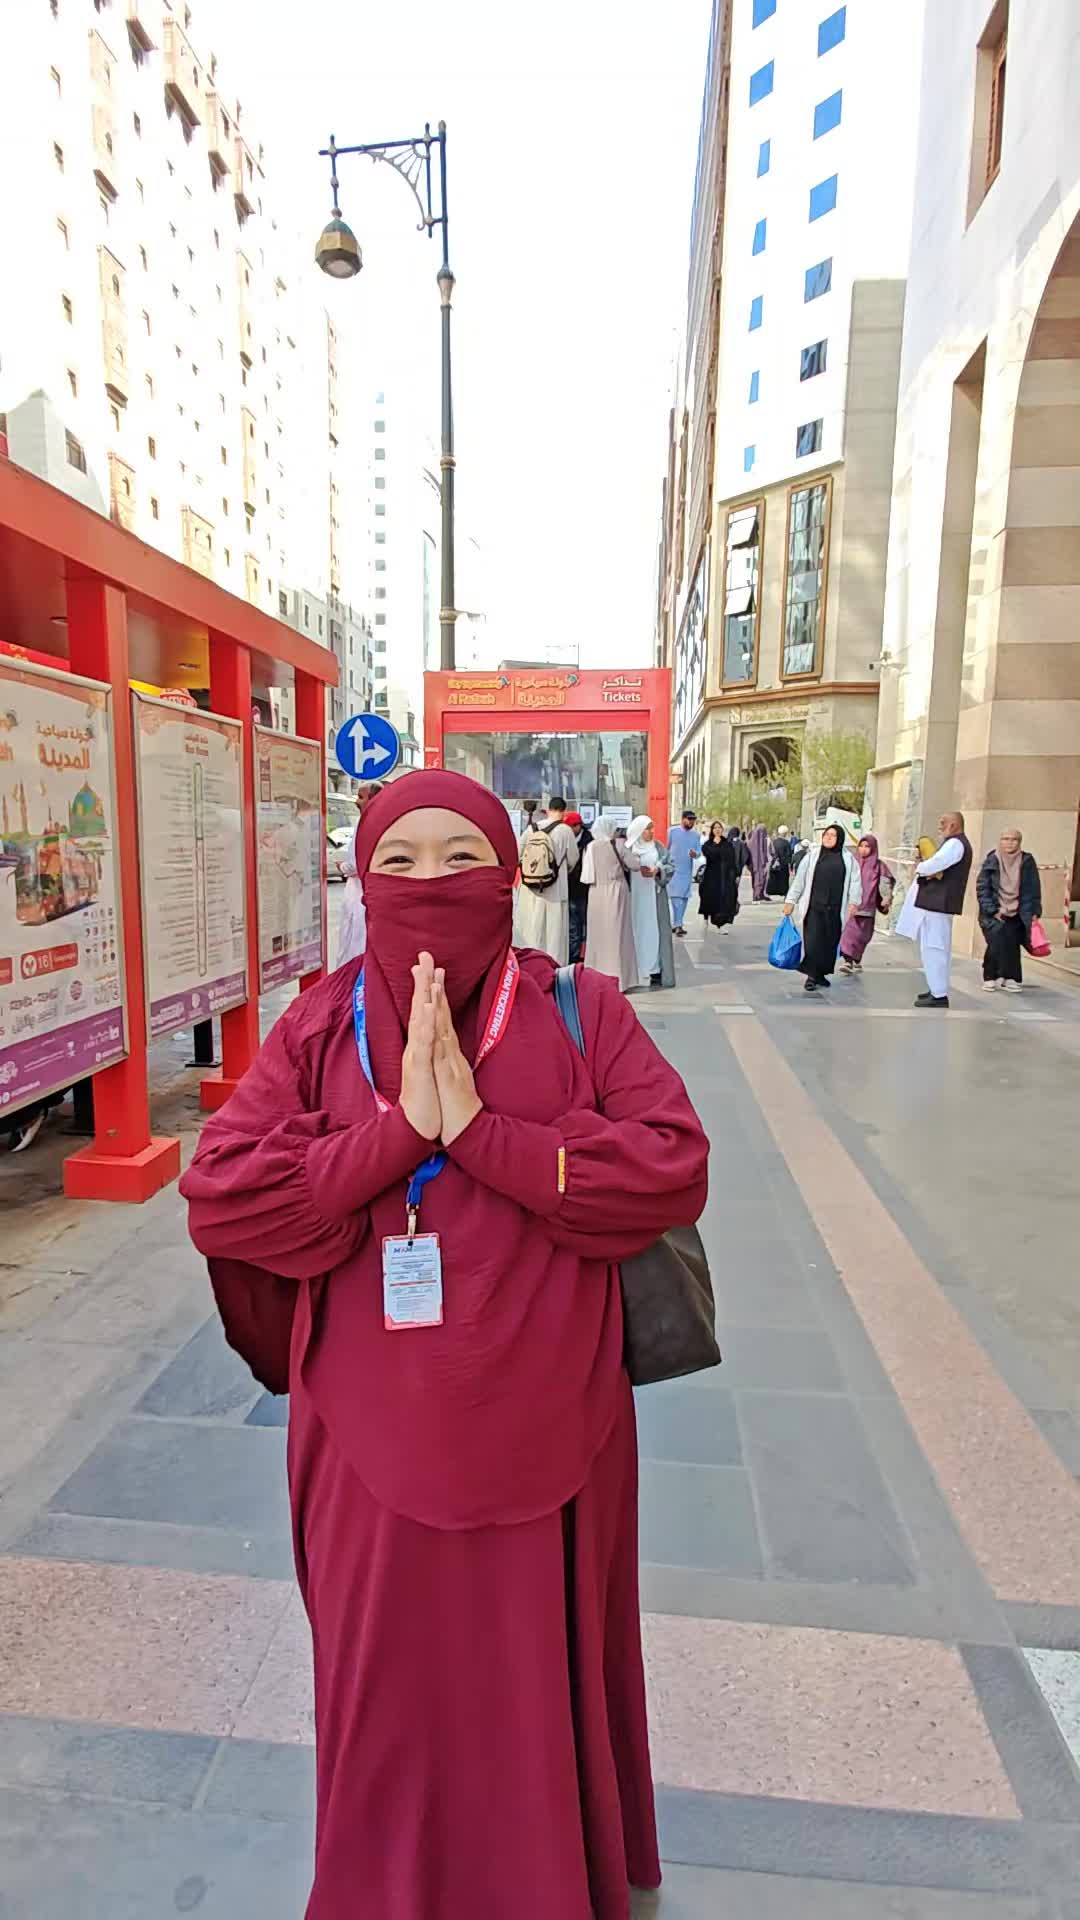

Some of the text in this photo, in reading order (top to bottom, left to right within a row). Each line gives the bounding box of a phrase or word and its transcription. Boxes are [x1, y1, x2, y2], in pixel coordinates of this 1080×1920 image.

[602, 691, 641, 702] Tickets
[38, 742, 91, 772] المدينة
[38, 954, 50, 969] 16
[489, 989, 510, 1038] TICKETING
